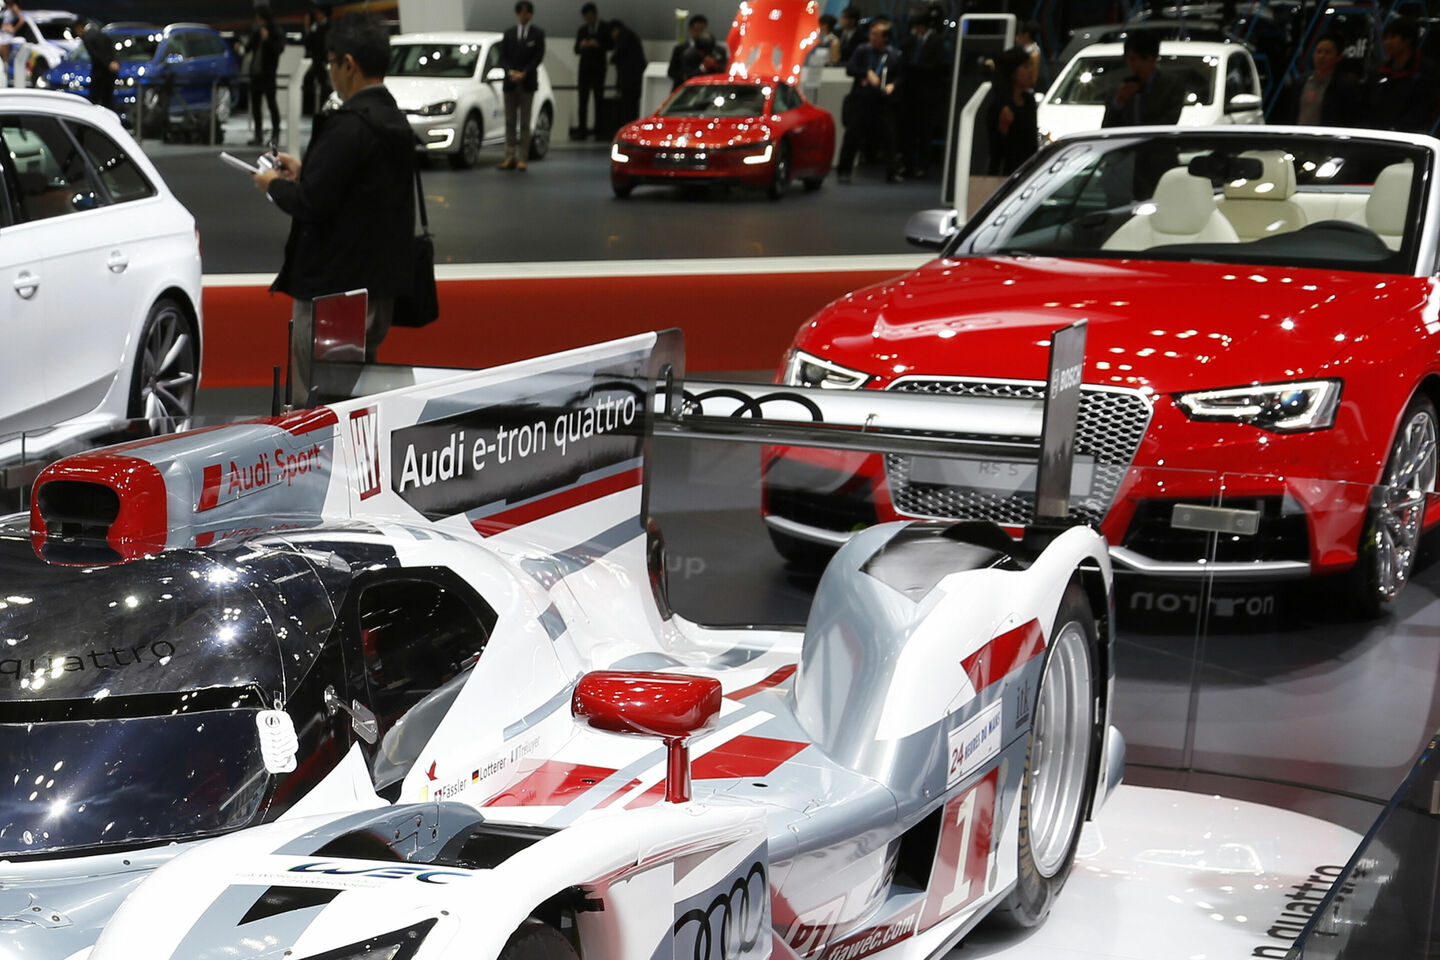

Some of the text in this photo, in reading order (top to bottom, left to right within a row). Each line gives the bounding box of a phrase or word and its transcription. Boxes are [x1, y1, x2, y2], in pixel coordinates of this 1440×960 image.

[1059, 364, 1081, 394] BOSCH
[228, 443, 322, 495] Audi Sport
[399, 395, 637, 492] Audi e-tron quattro
[950, 742, 964, 775] 24
[938, 788, 978, 916] 1
[1266, 864, 1347, 942] quattro
